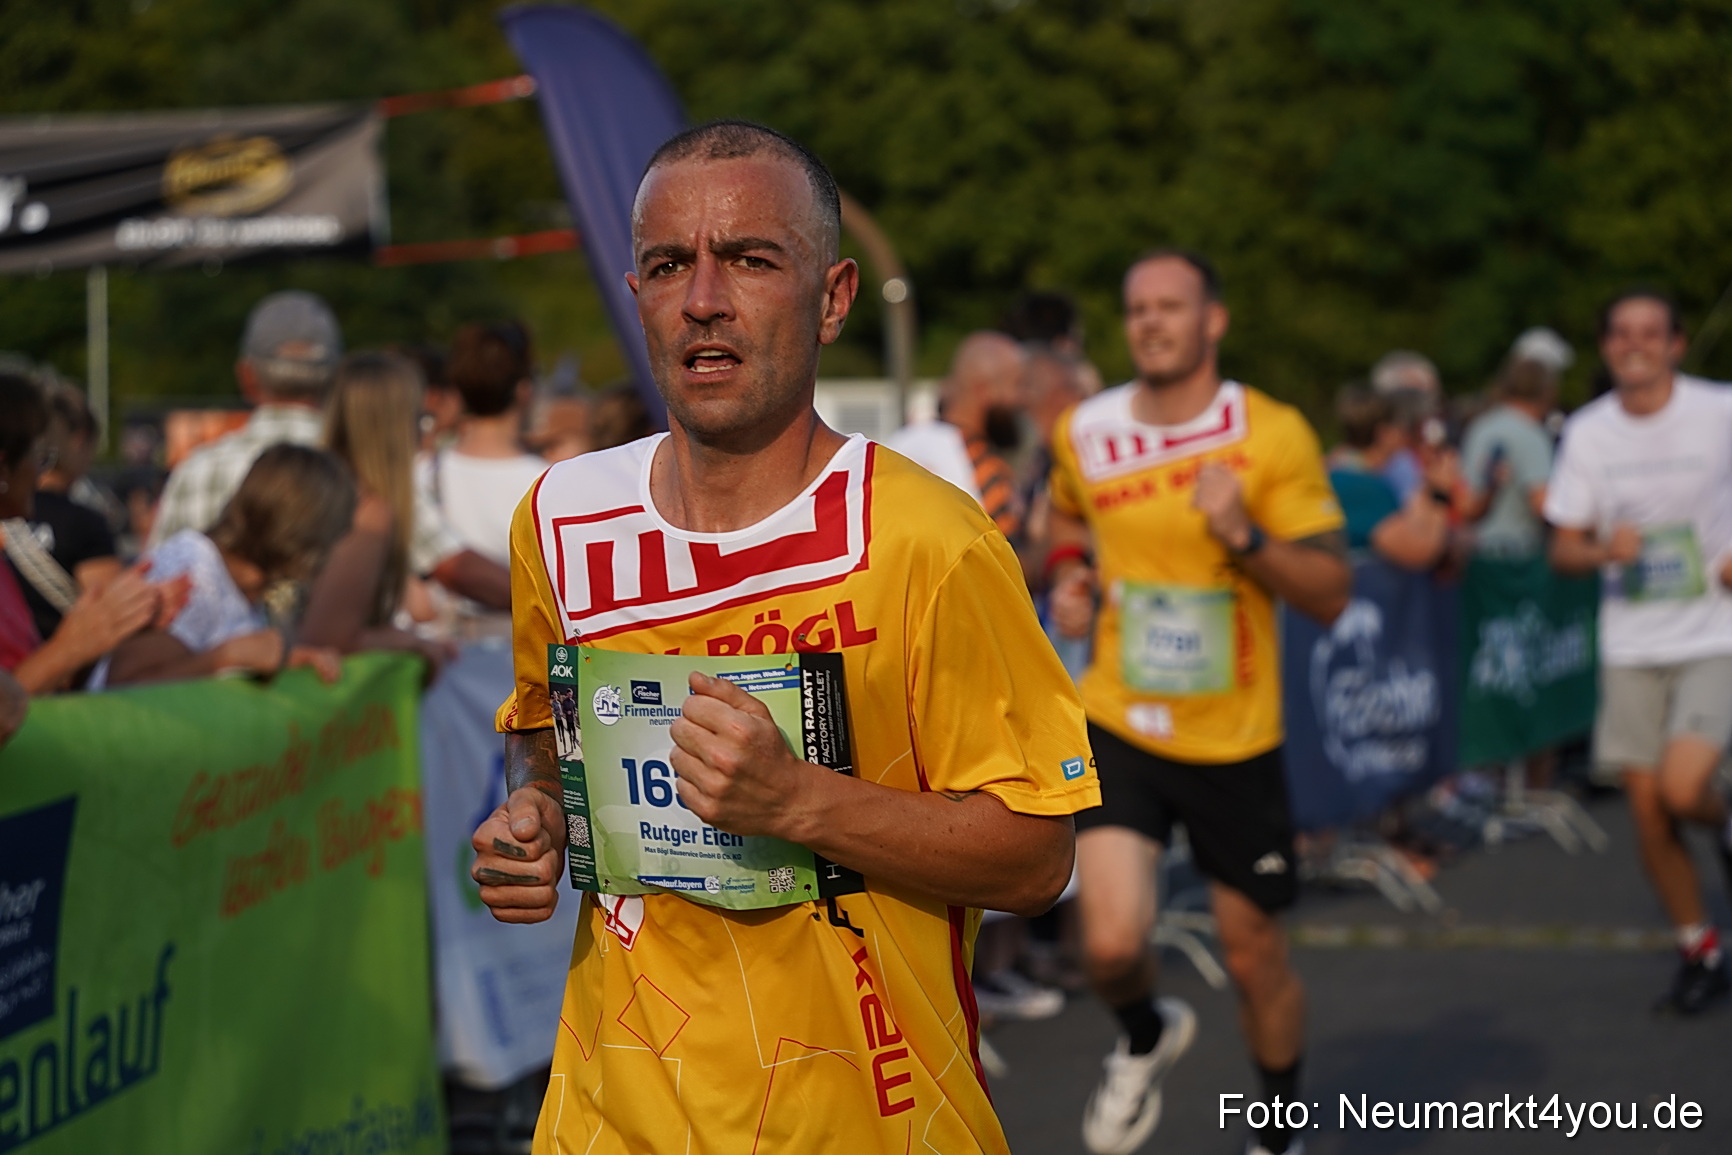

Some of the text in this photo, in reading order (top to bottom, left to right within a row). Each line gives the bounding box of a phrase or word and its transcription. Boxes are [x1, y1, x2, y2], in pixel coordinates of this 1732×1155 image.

[550, 664, 574, 679] AOK
[624, 704, 682, 717] Firmenlau
[803, 669, 819, 765] 20 % RABATT
[816, 670, 832, 764] FACTORY OUTLET
[639, 821, 698, 847] Rutger
[644, 846, 656, 854] Max
[669, 848, 698, 858] Bauservice
[699, 851, 716, 859] GmbH
